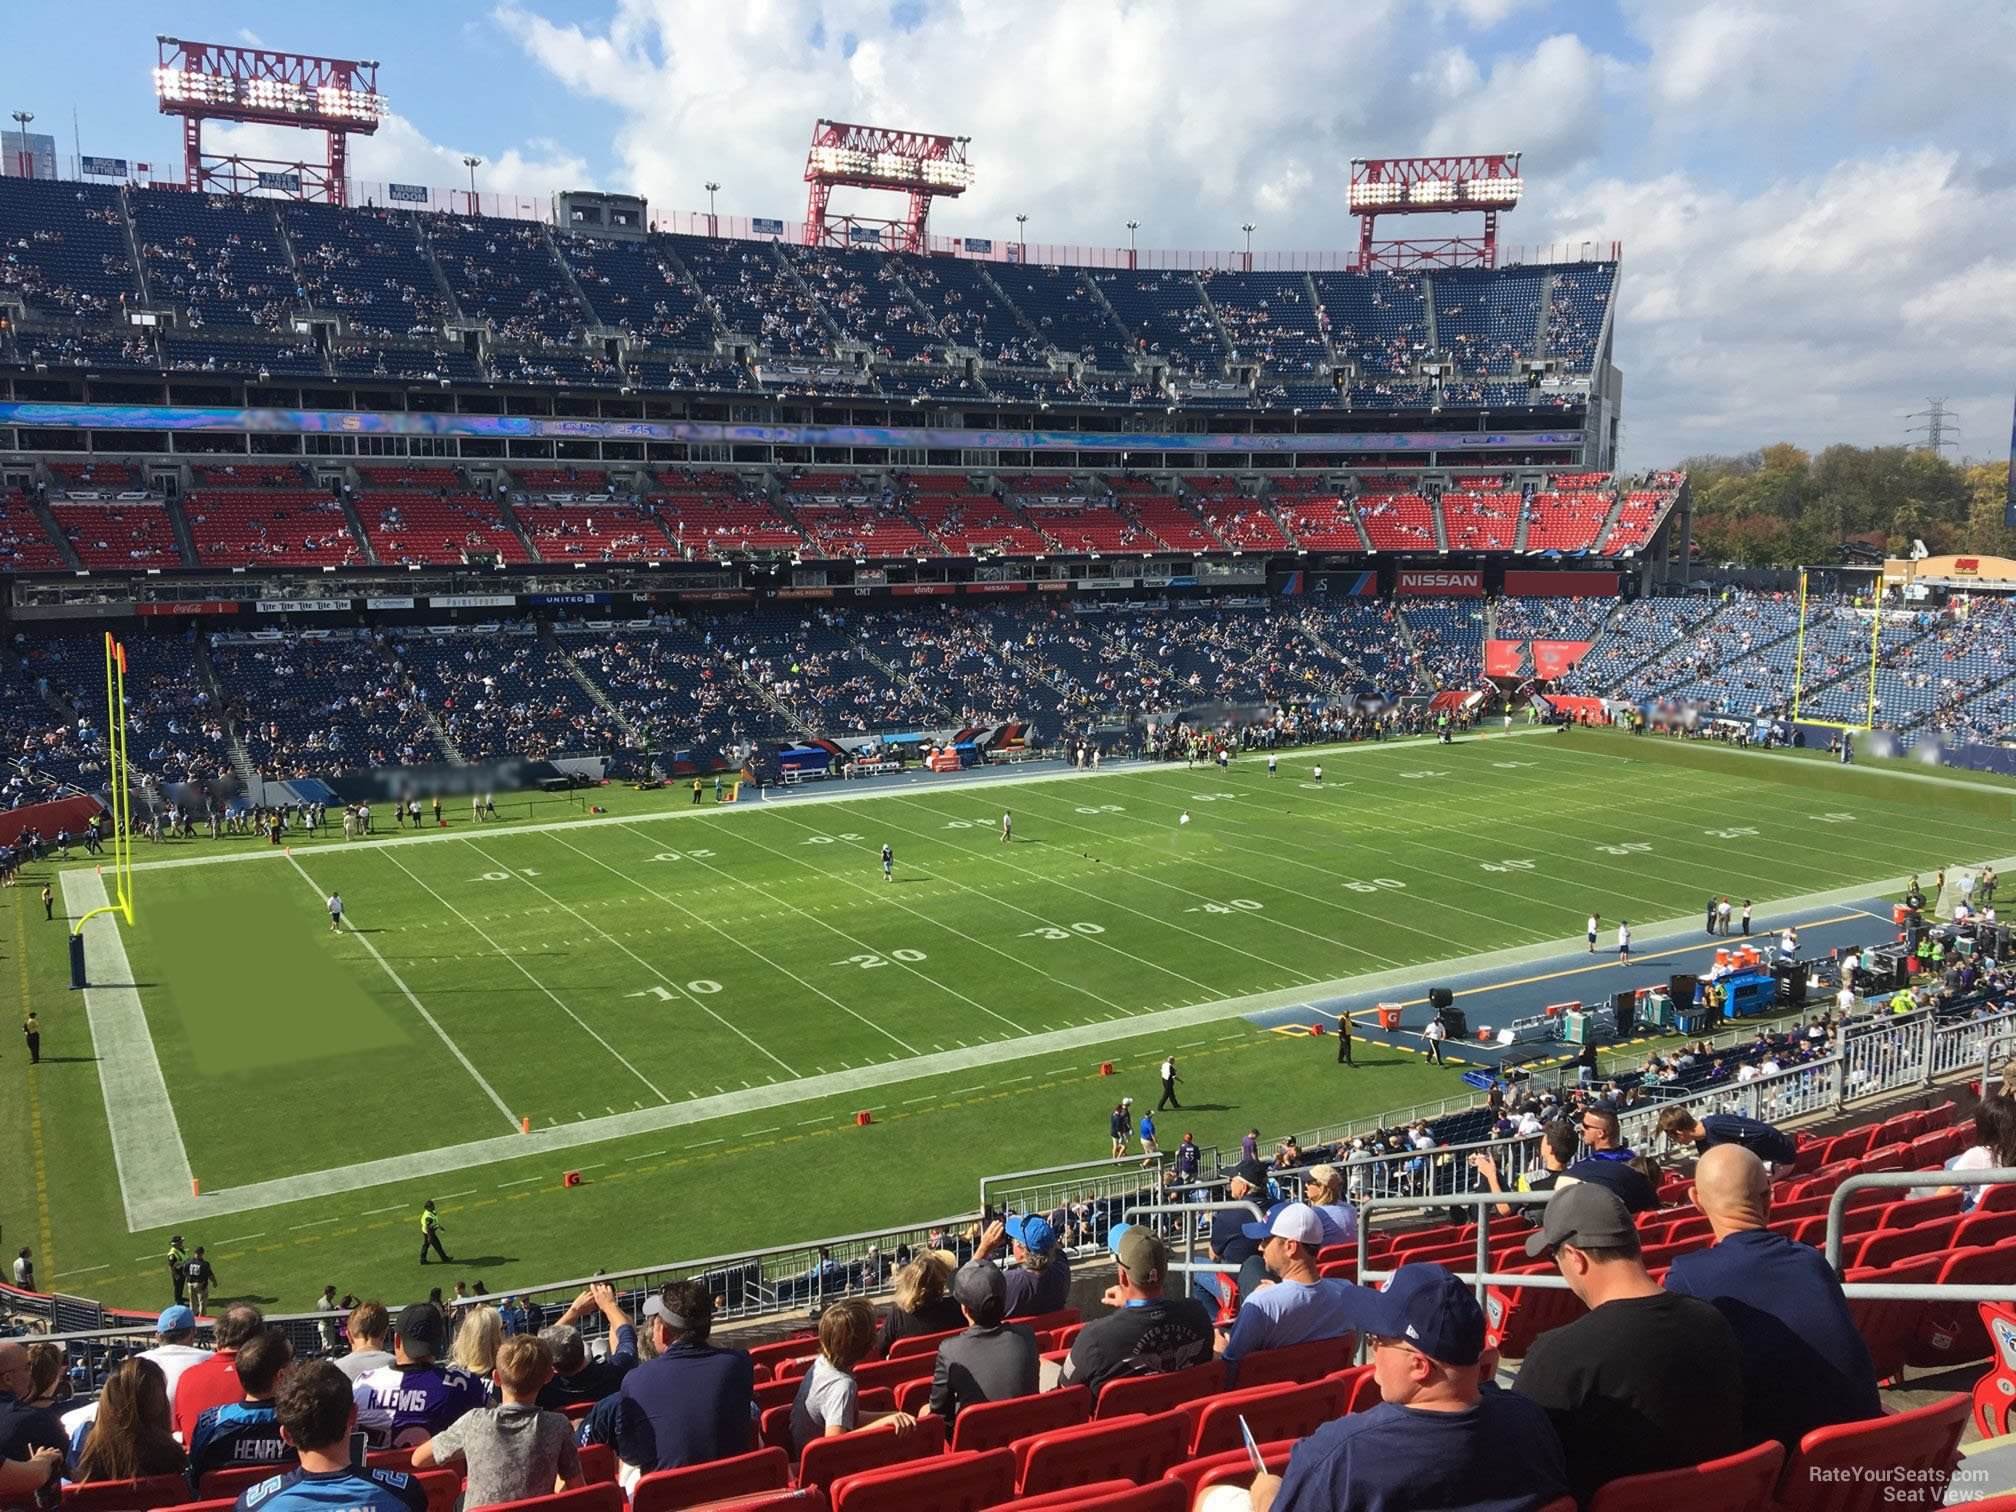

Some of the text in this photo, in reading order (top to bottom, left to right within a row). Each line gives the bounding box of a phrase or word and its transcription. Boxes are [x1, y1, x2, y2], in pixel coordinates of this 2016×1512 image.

[92, 157, 117, 168] BRUCE
[83, 164, 127, 177] MATTHEWS
[264, 172, 293, 182] STEVE
[391, 191, 426, 202] MOON
[1402, 574, 1478, 587] NISSAN
[767, 590, 777, 598] LP
[855, 587, 871, 596] CMT
[261, 601, 348, 611] Lite Lite Lite Lite Lite
[654, 848, 717, 862] 20
[1479, 858, 1537, 872] 40
[482, 867, 544, 881] 10
[1341, 877, 1407, 893] 50
[1201, 898, 1265, 915] 40
[1033, 921, 1106, 941] 30
[849, 948, 928, 970] 20
[646, 979, 724, 1002] 10
[1387, 1012, 1397, 1023] G
[1132, 1324, 1198, 1355] UNITED STATES
[2002, 1382, 2010, 1391] G
[233, 1438, 286, 1460] HENRY
